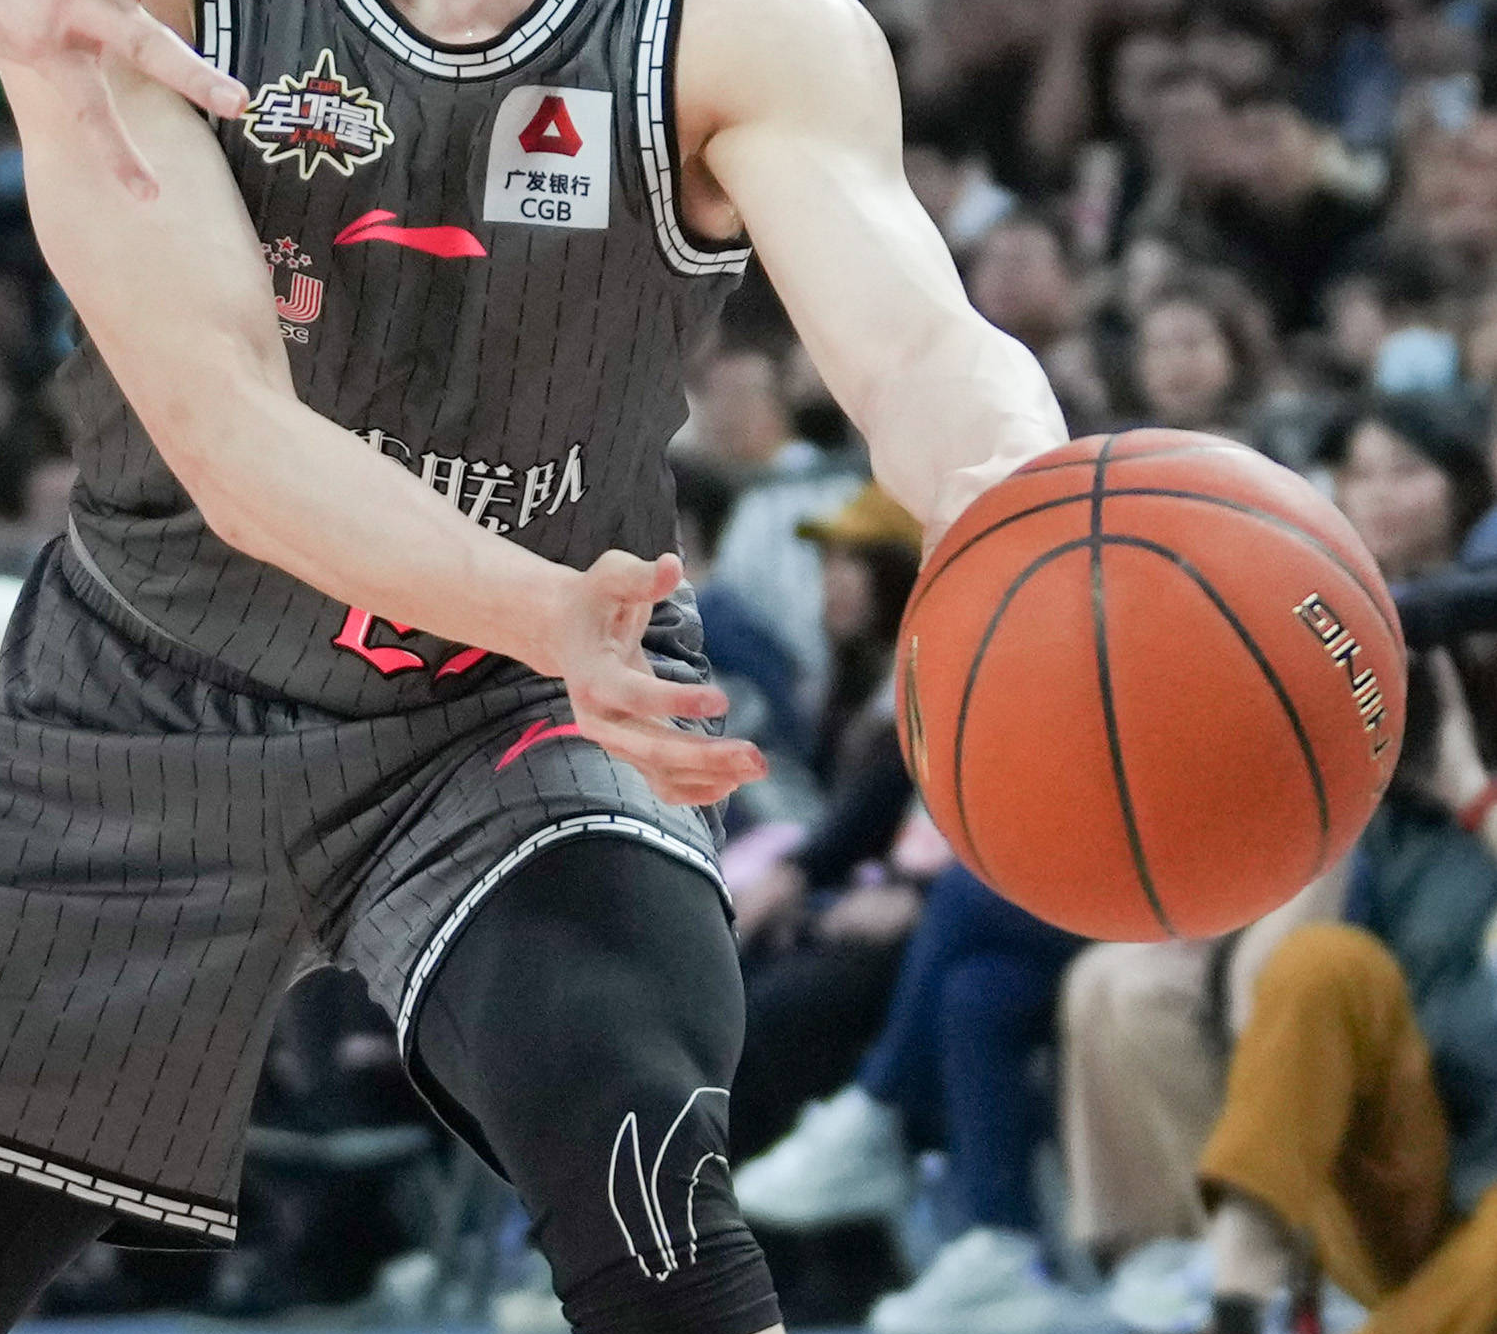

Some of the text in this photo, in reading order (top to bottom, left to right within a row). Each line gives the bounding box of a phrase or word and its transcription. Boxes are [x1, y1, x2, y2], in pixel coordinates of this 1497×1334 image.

[254, 92, 379, 151] 全明星
[504, 169, 591, 197] 广发银行
[520, 198, 572, 222] CGB
